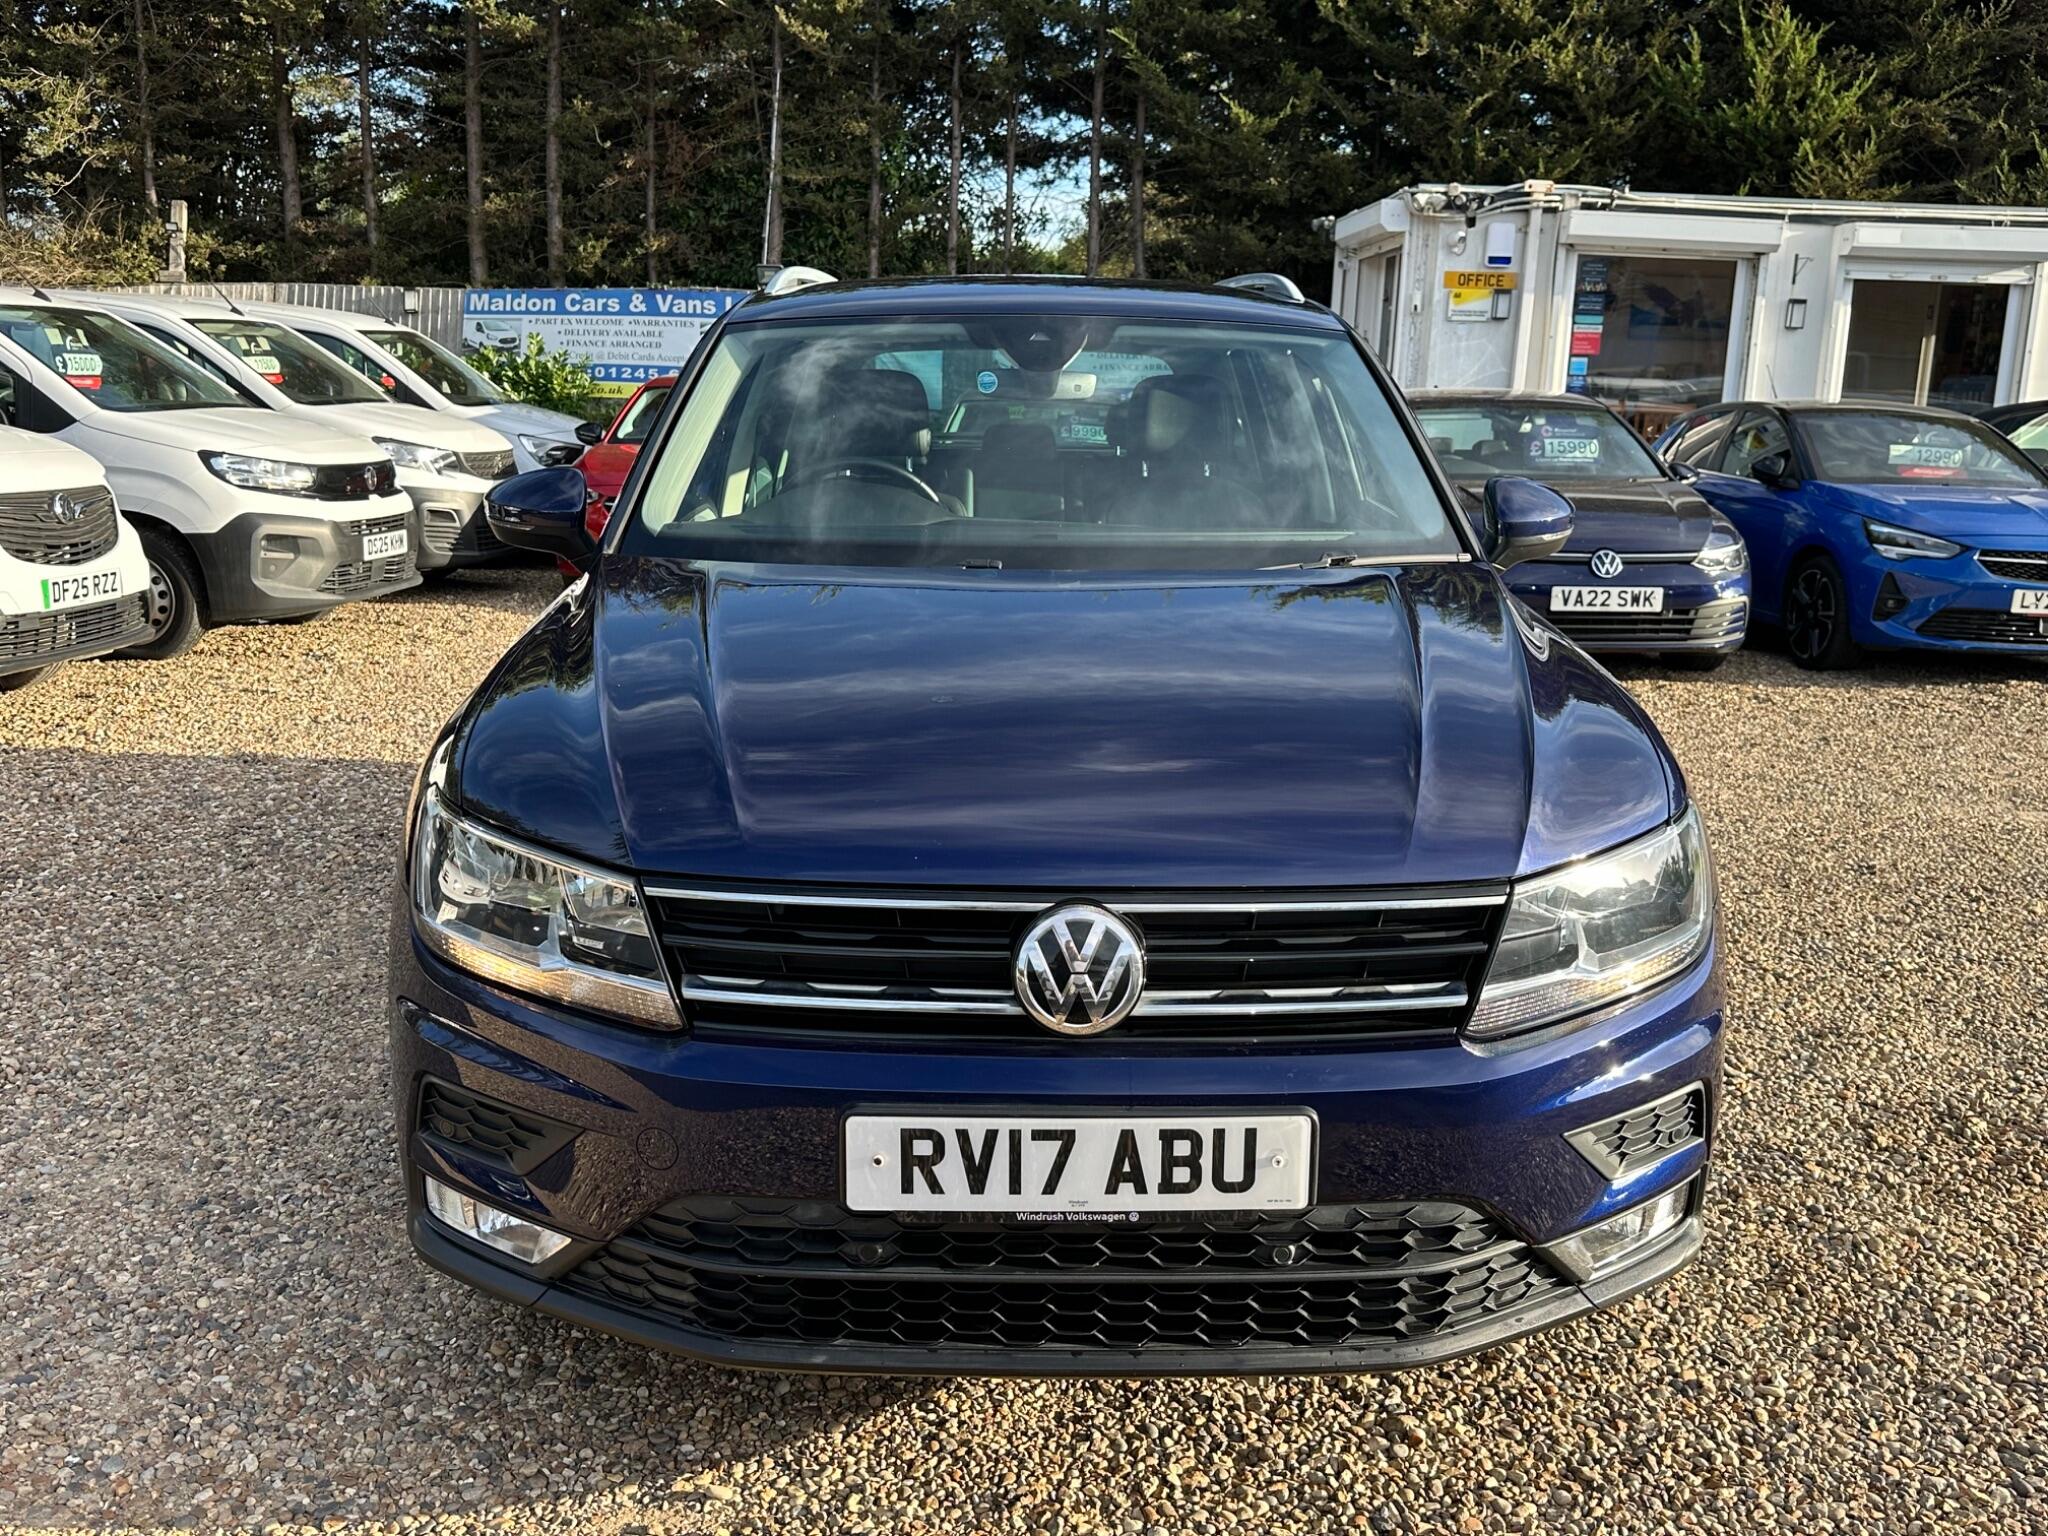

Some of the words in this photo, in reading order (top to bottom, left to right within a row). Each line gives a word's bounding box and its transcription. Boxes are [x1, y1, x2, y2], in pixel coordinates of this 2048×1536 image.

[1457, 273, 1505, 287] OFFICE
[469, 293, 557, 312] Maldon
[564, 293, 621, 313] Cars
[629, 293, 647, 313] &
[655, 294, 717, 315] Vans
[534, 318, 557, 326] PART
[560, 318, 573, 326] EX
[575, 318, 624, 326] WELCOME
[633, 319, 695, 328] WARRANTIES
[563, 328, 611, 337] DELIVERY
[613, 330, 664, 338] AVAILABLE
[566, 339, 606, 348] FINANCE
[610, 340, 662, 349] ARRANGED
[607, 351, 630, 360] Debit
[631, 352, 656, 361] Cards
[1916, 448, 1961, 465] 12990
[367, 535, 389, 556] DS25
[51, 577, 90, 603] DF25
[92, 571, 118, 596] RZZ
[1561, 589, 1611, 607] VA22
[1617, 590, 1655, 607] SWK
[899, 1127, 1077, 1196] RV17
[1103, 1127, 1258, 1196] ABU
[1015, 1212, 1065, 1221] Windrush
[1065, 1212, 1126, 1223] Volkswagen
